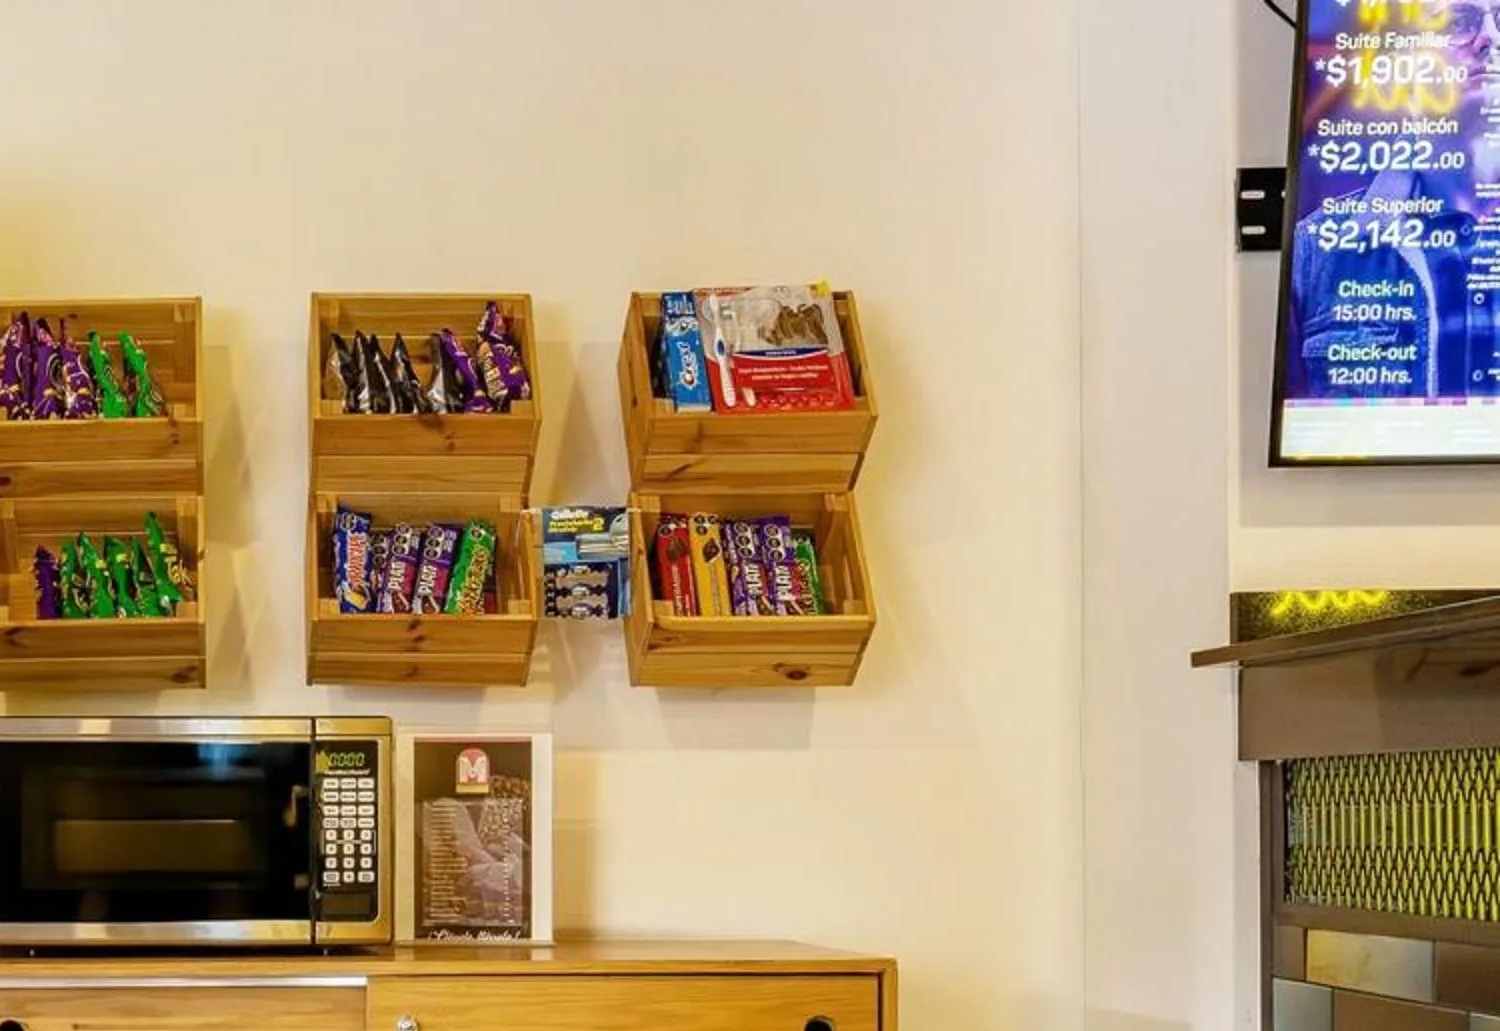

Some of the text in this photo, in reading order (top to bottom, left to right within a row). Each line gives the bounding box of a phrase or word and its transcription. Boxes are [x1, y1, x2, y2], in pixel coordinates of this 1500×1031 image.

[1335, 31, 1452, 49] Suite Familiar
[1317, 117, 1458, 136] Suite con balcón
[1322, 195, 1444, 217] Suite Superior
[1339, 279, 1414, 297] Check-in
[1333, 304, 1417, 321] 15:00 hrs.
[1327, 344, 1417, 361] Check-out
[1328, 366, 1413, 384] 12:00 hrs.
